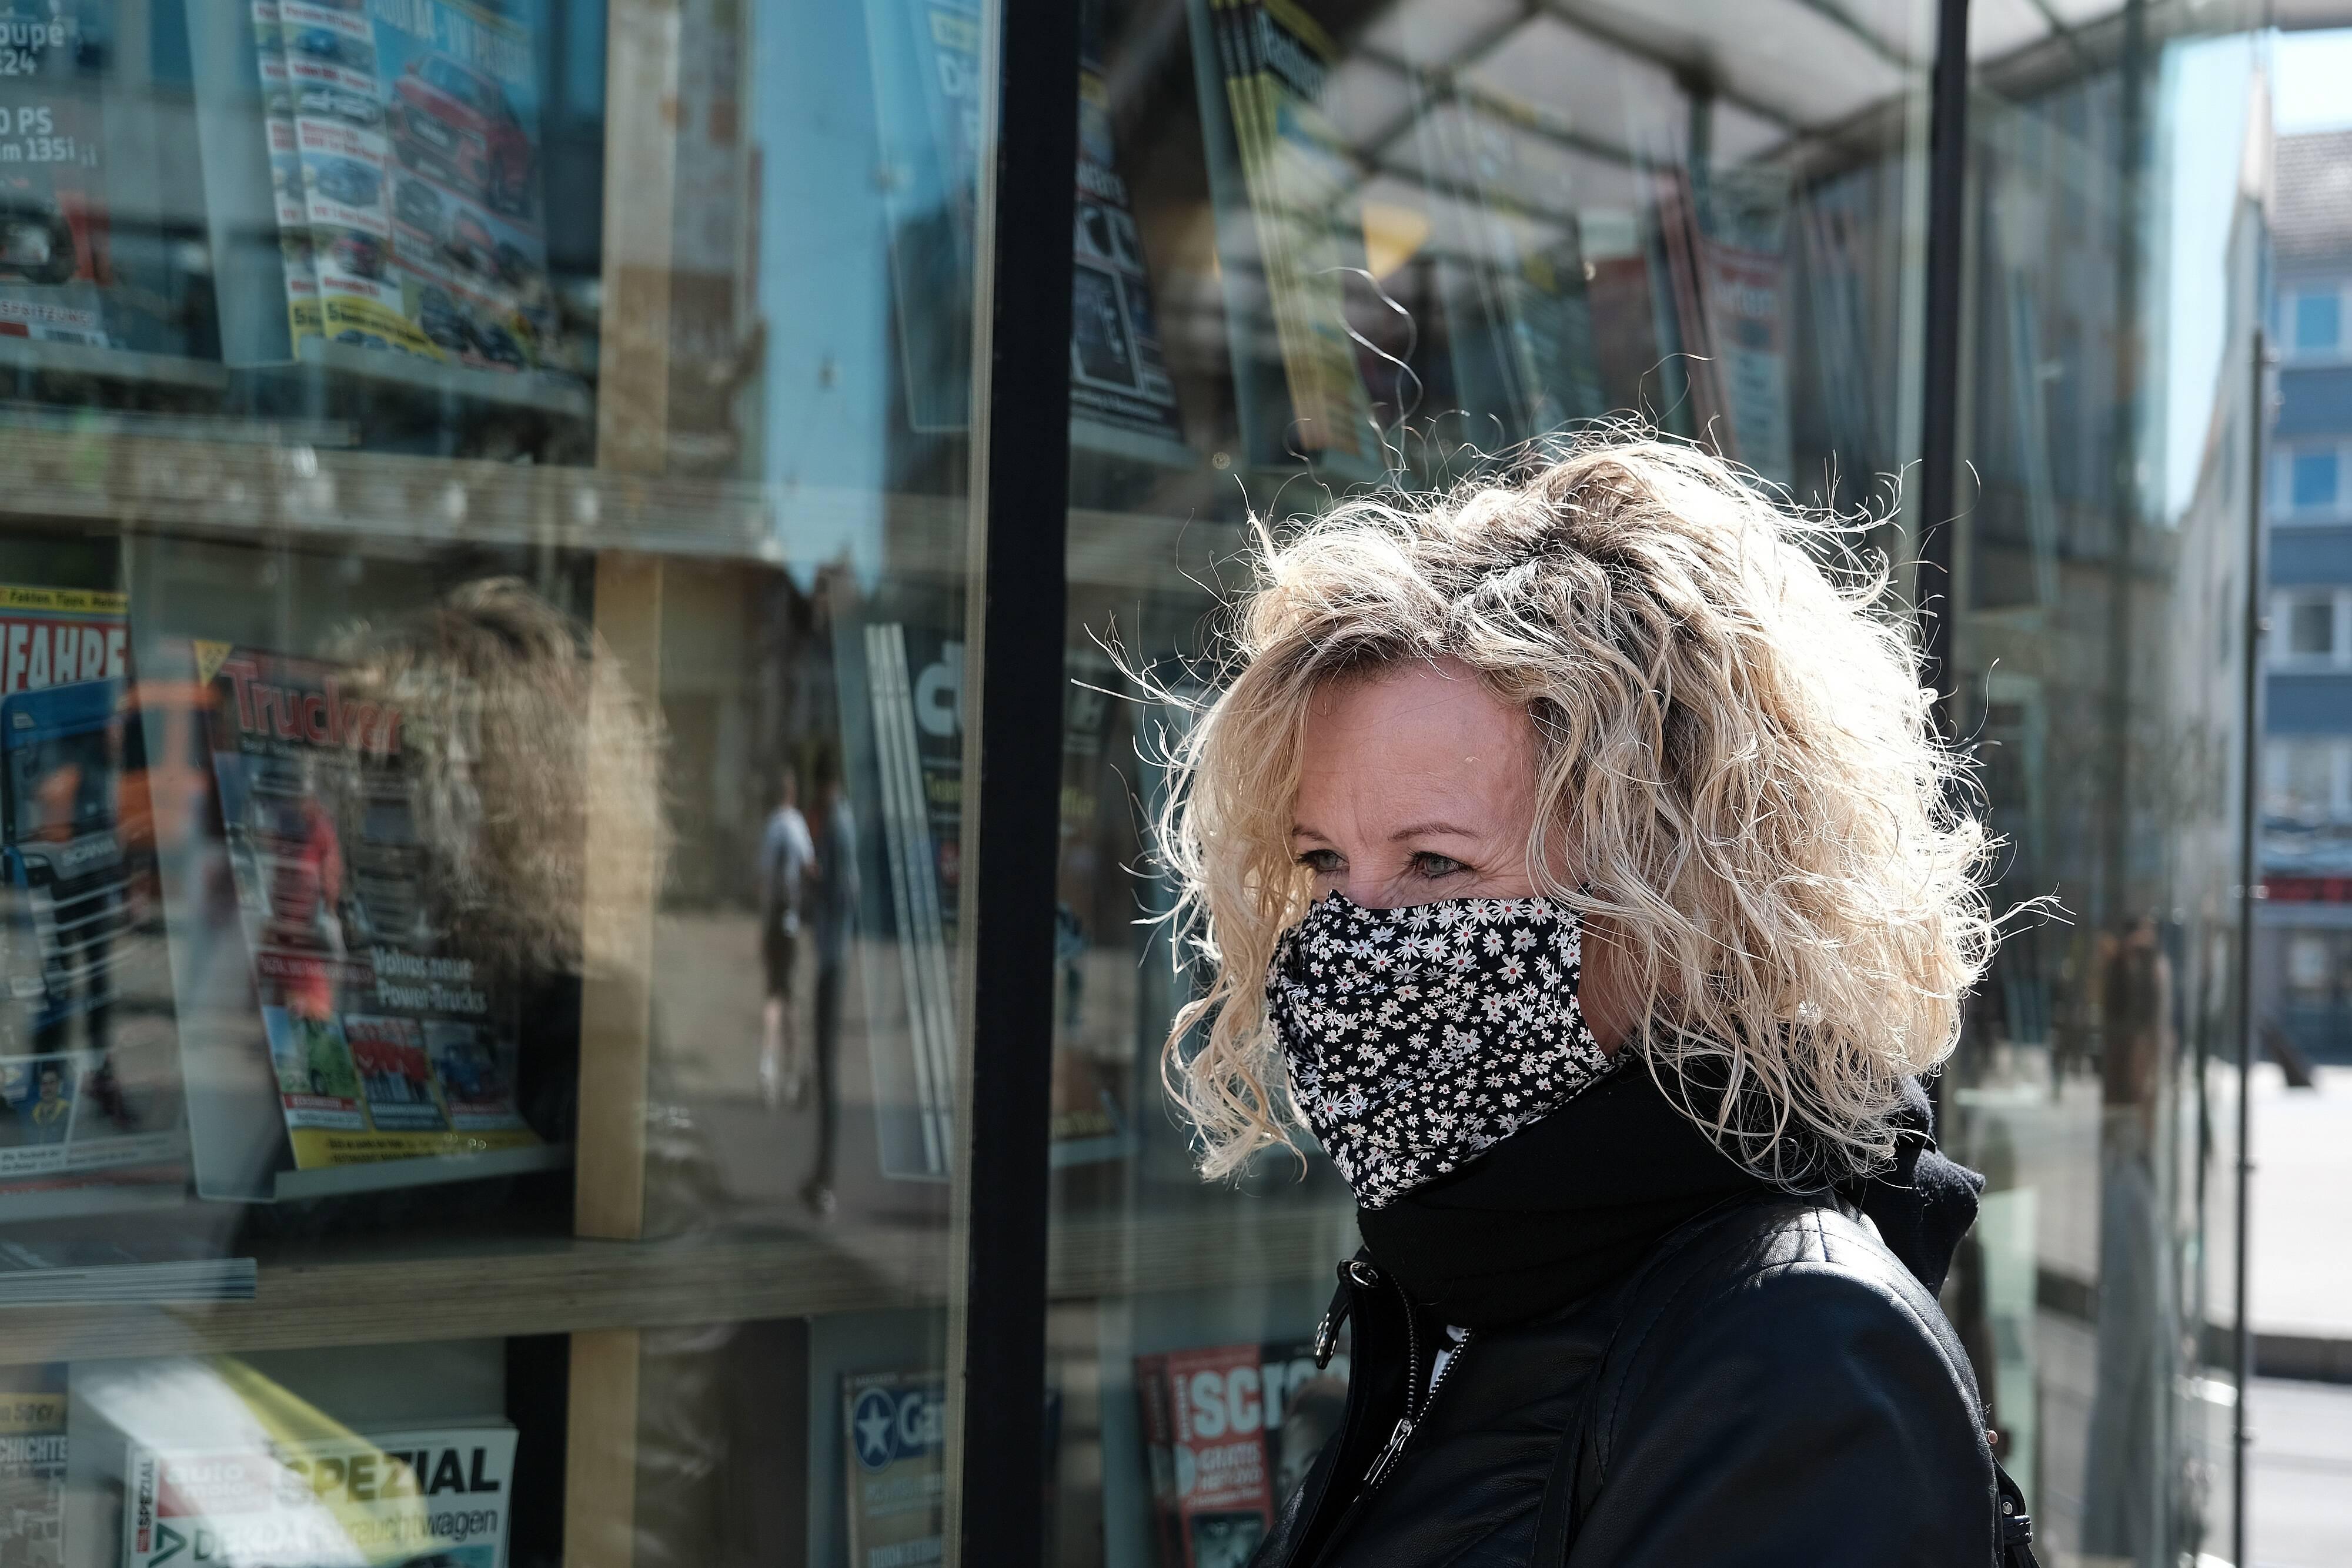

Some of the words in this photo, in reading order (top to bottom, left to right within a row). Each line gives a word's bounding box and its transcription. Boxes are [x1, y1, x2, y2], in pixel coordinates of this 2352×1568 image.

[18, 106, 54, 136] PS
[219, 657, 403, 754] Trucker
[139, 1459, 153, 1529] SPEZIAL
[274, 1444, 499, 1507] SPEZIAL
